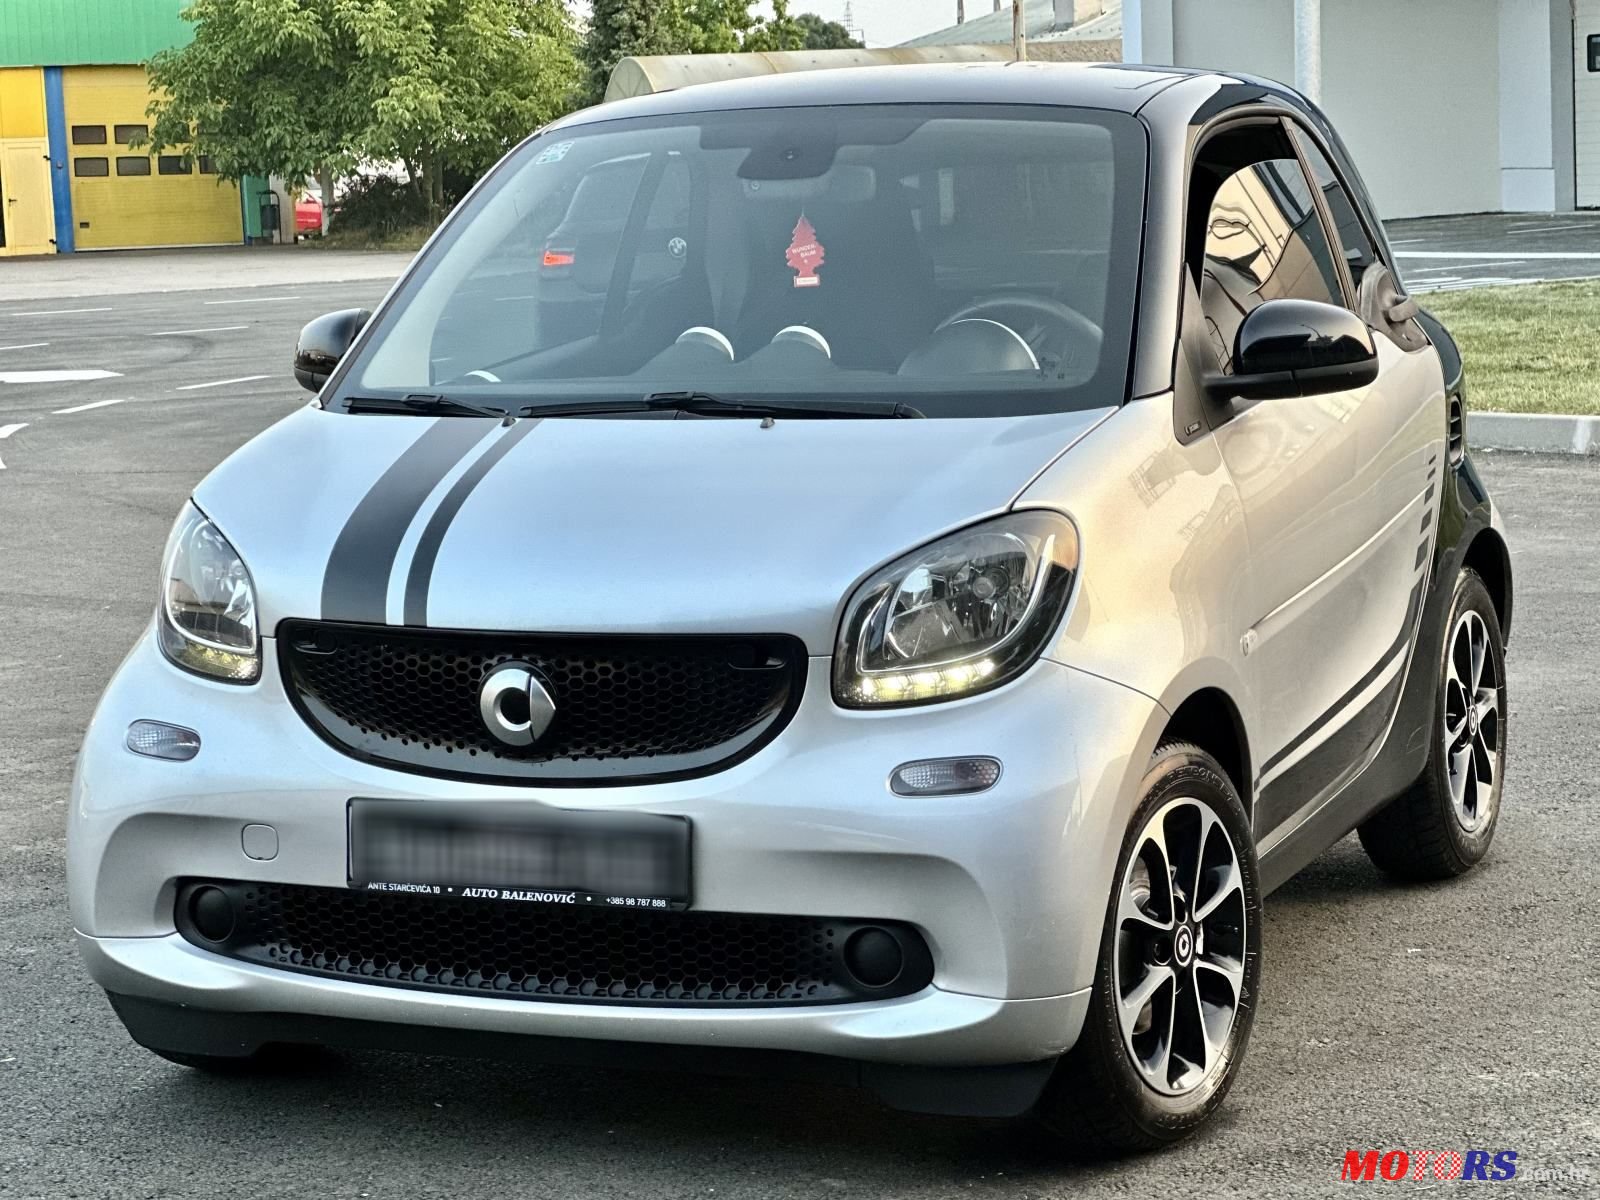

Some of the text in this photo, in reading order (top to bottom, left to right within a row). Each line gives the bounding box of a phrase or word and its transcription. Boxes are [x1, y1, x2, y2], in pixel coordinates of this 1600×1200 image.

[367, 882, 387, 891] ANTE
[433, 886, 441, 894] 10
[462, 887, 576, 904] AUTO BALENOVIĆ
[625, 897, 635, 906] 98
[637, 898, 650, 907] 787
